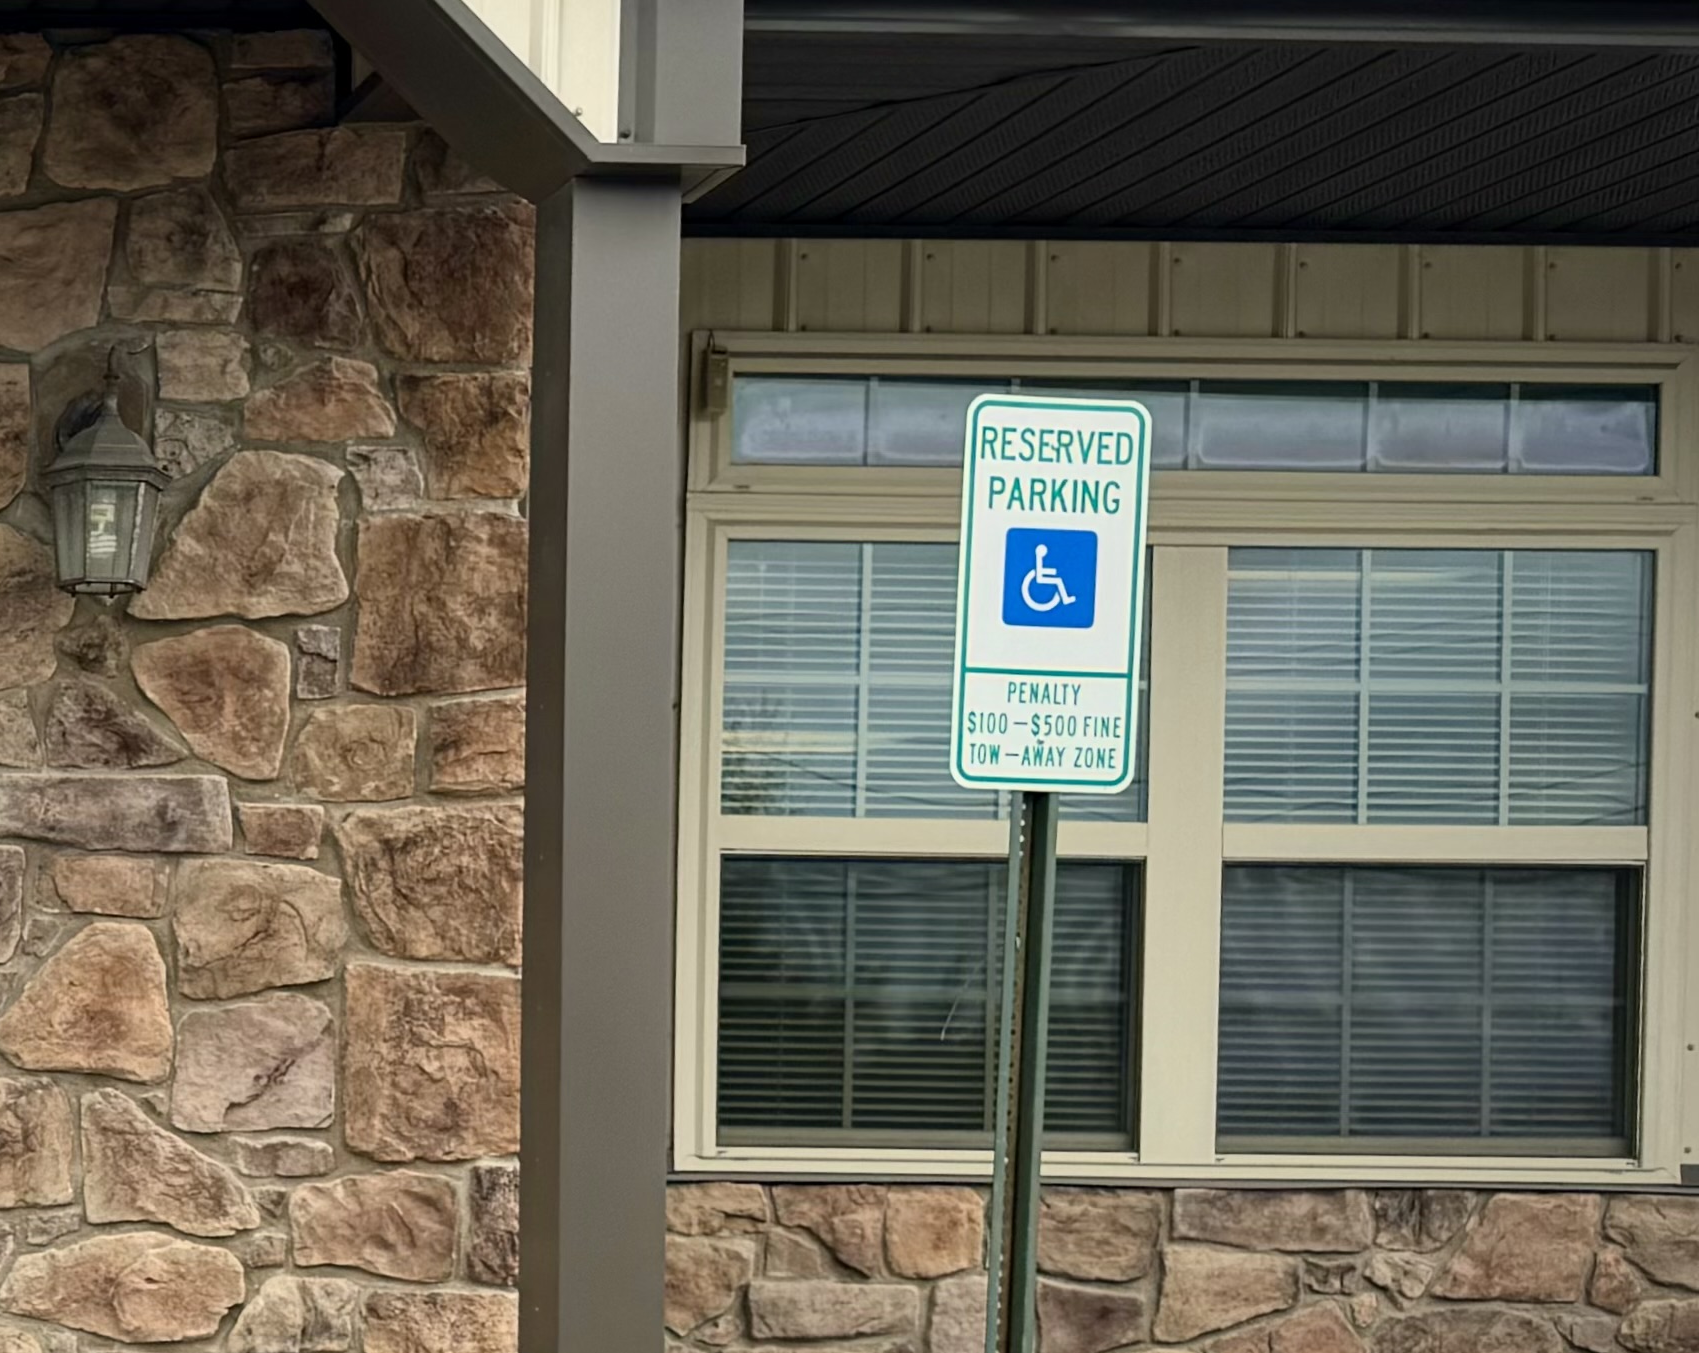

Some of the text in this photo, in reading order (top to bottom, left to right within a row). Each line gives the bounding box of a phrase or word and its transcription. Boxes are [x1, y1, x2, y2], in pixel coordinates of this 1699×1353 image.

[980, 425, 1133, 466] RESERVED
[987, 476, 1121, 514] PARKING
[1007, 681, 1081, 705] PENALTY
[1083, 716, 1121, 738] FINE
[1073, 747, 1116, 769] ZONE
